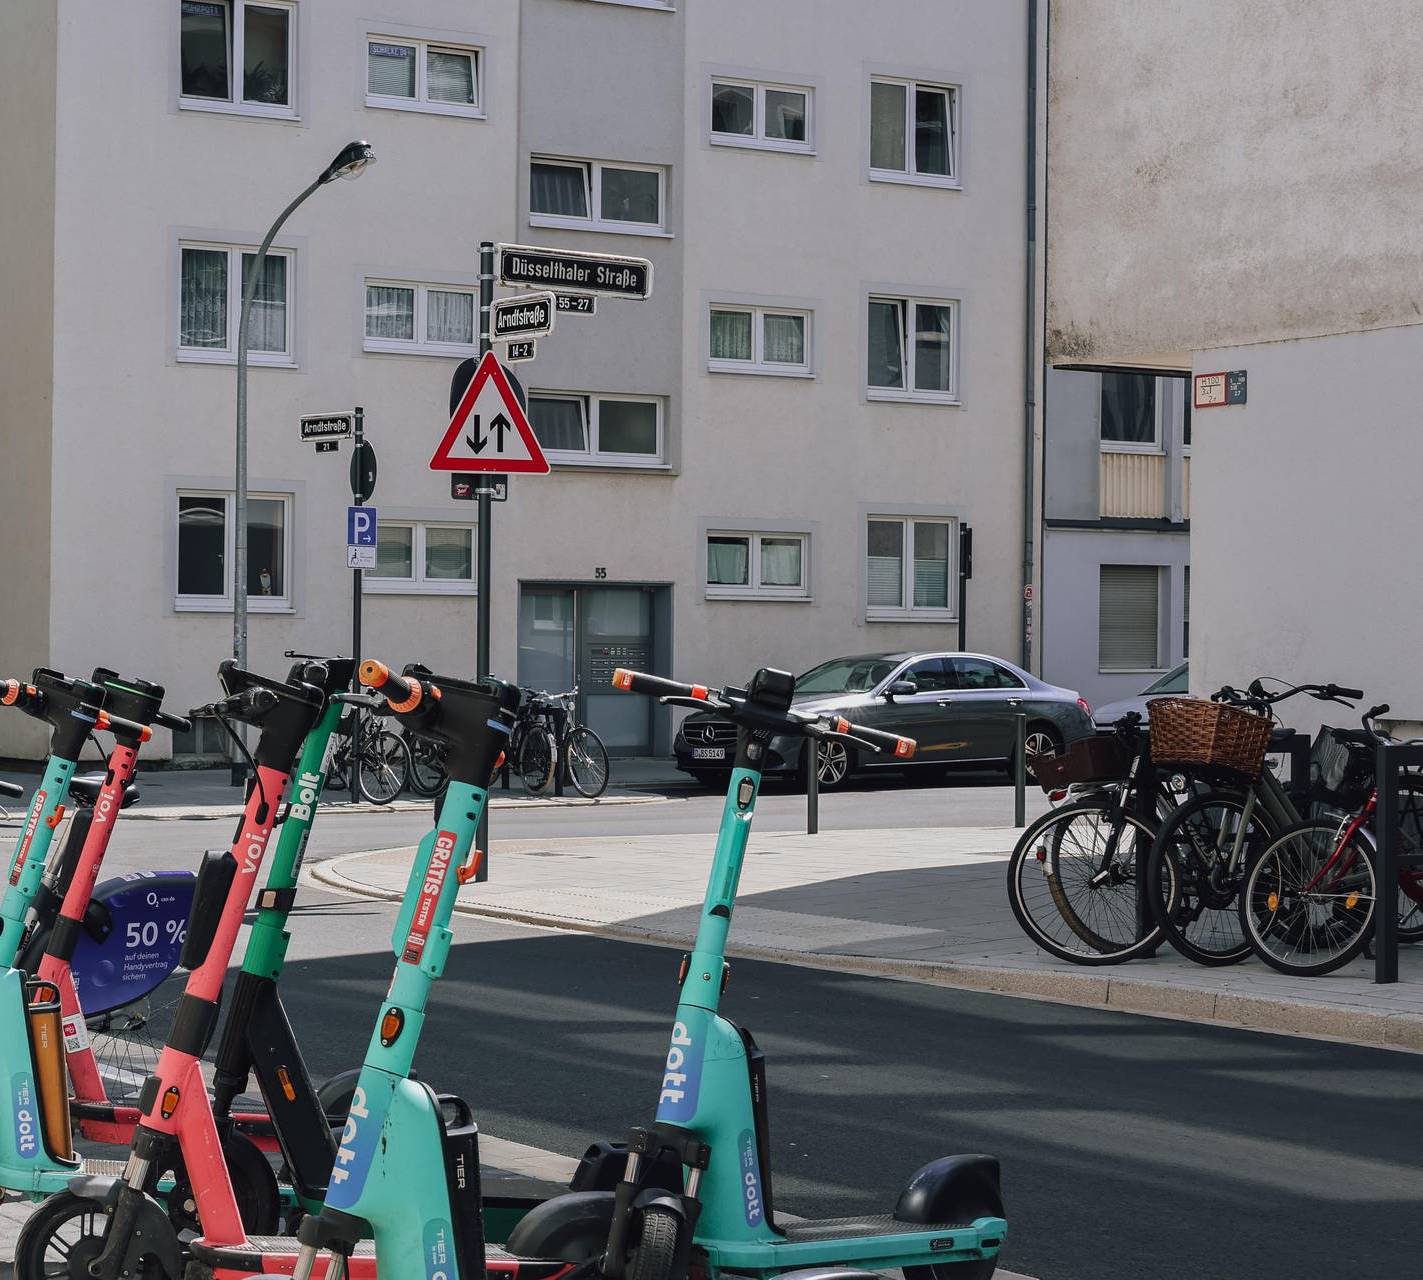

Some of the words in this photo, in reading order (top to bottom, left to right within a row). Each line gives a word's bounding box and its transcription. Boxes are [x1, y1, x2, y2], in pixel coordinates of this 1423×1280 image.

[512, 257, 591, 283] Düsselthaler
[596, 266, 638, 288] Straße
[497, 303, 546, 330] Arndtstraße
[304, 419, 347, 435] Arndtstraße
[354, 511, 370, 544] P
[594, 568, 607, 579] 55
[290, 771, 321, 822] Bolt
[25, 795, 45, 837] GRATIS
[241, 828, 268, 876] voi.
[424, 836, 454, 897] GRATIS
[125, 920, 159, 948] 50
[165, 918, 187, 945] %
[123, 961, 168, 972] Handyvertrag
[124, 952, 137, 962] auf
[137, 951, 160, 961] deinen
[122, 972, 146, 982] sichern
[40, 1023, 48, 1050] TIER
[659, 1021, 693, 1105] dott
[22, 1079, 30, 1106] TIER
[17, 1108, 34, 1152] dott
[333, 1085, 370, 1186] dott
[745, 1136, 754, 1167] TIER
[456, 1153, 466, 1190] TIER
[745, 1172, 761, 1220] dott
[436, 1227, 446, 1265] TIER
